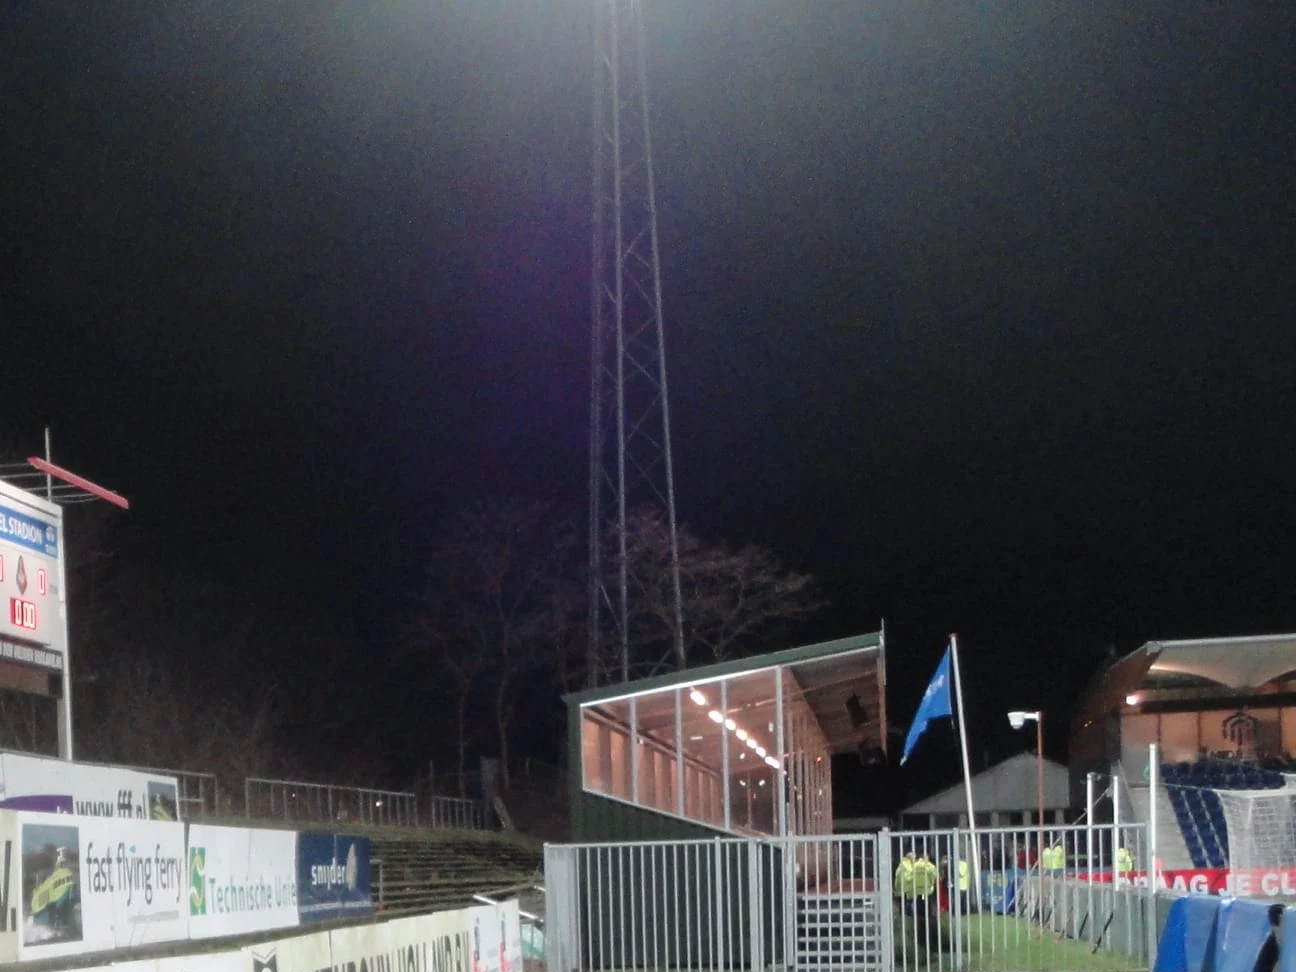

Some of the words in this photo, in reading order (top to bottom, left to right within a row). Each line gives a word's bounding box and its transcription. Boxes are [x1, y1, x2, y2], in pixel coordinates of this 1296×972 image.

[9, 516, 43, 546] STADION
[86, 842, 114, 893] fast
[116, 842, 153, 906] flying
[154, 844, 182, 901] ferry
[1218, 873, 1251, 896] JE
[209, 875, 273, 915] Technische
[275, 875, 297, 908] Unie
